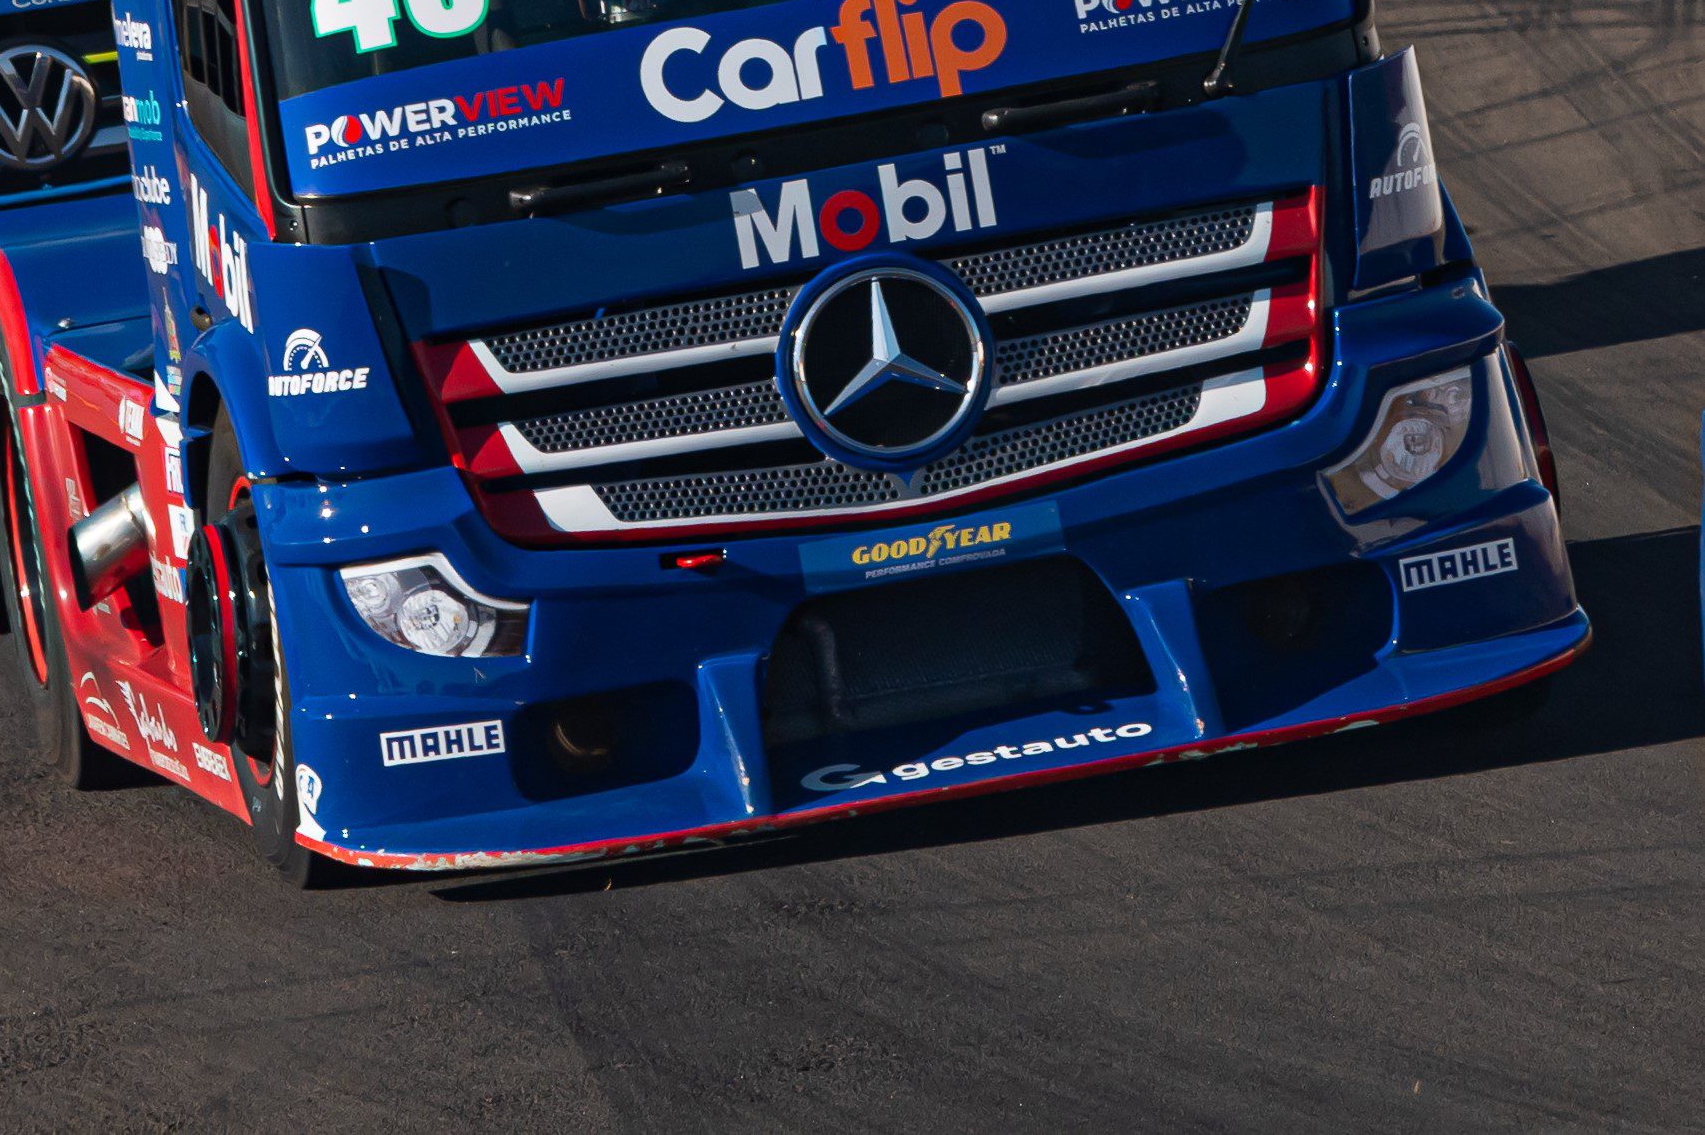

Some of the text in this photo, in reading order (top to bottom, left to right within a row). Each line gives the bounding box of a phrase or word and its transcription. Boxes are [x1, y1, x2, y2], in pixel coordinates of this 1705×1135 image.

[1080, 11, 1156, 34] PALHETAS
[1161, 6, 1181, 20] DE
[1186, 0, 1222, 16] ALTA
[304, 77, 565, 155] POWERVIEW
[310, 109, 573, 170] PALHETAS DE ALTA PERFORMANCE
[729, 148, 998, 271] Mobil
[189, 172, 254, 335] Mobil
[851, 521, 1012, 565] GOODYEAR
[865, 558, 937, 579] PERFORMANCE
[1403, 541, 1514, 586] MAHLE
[386, 724, 502, 763] MAHLE
[891, 722, 1154, 781] gestauto
